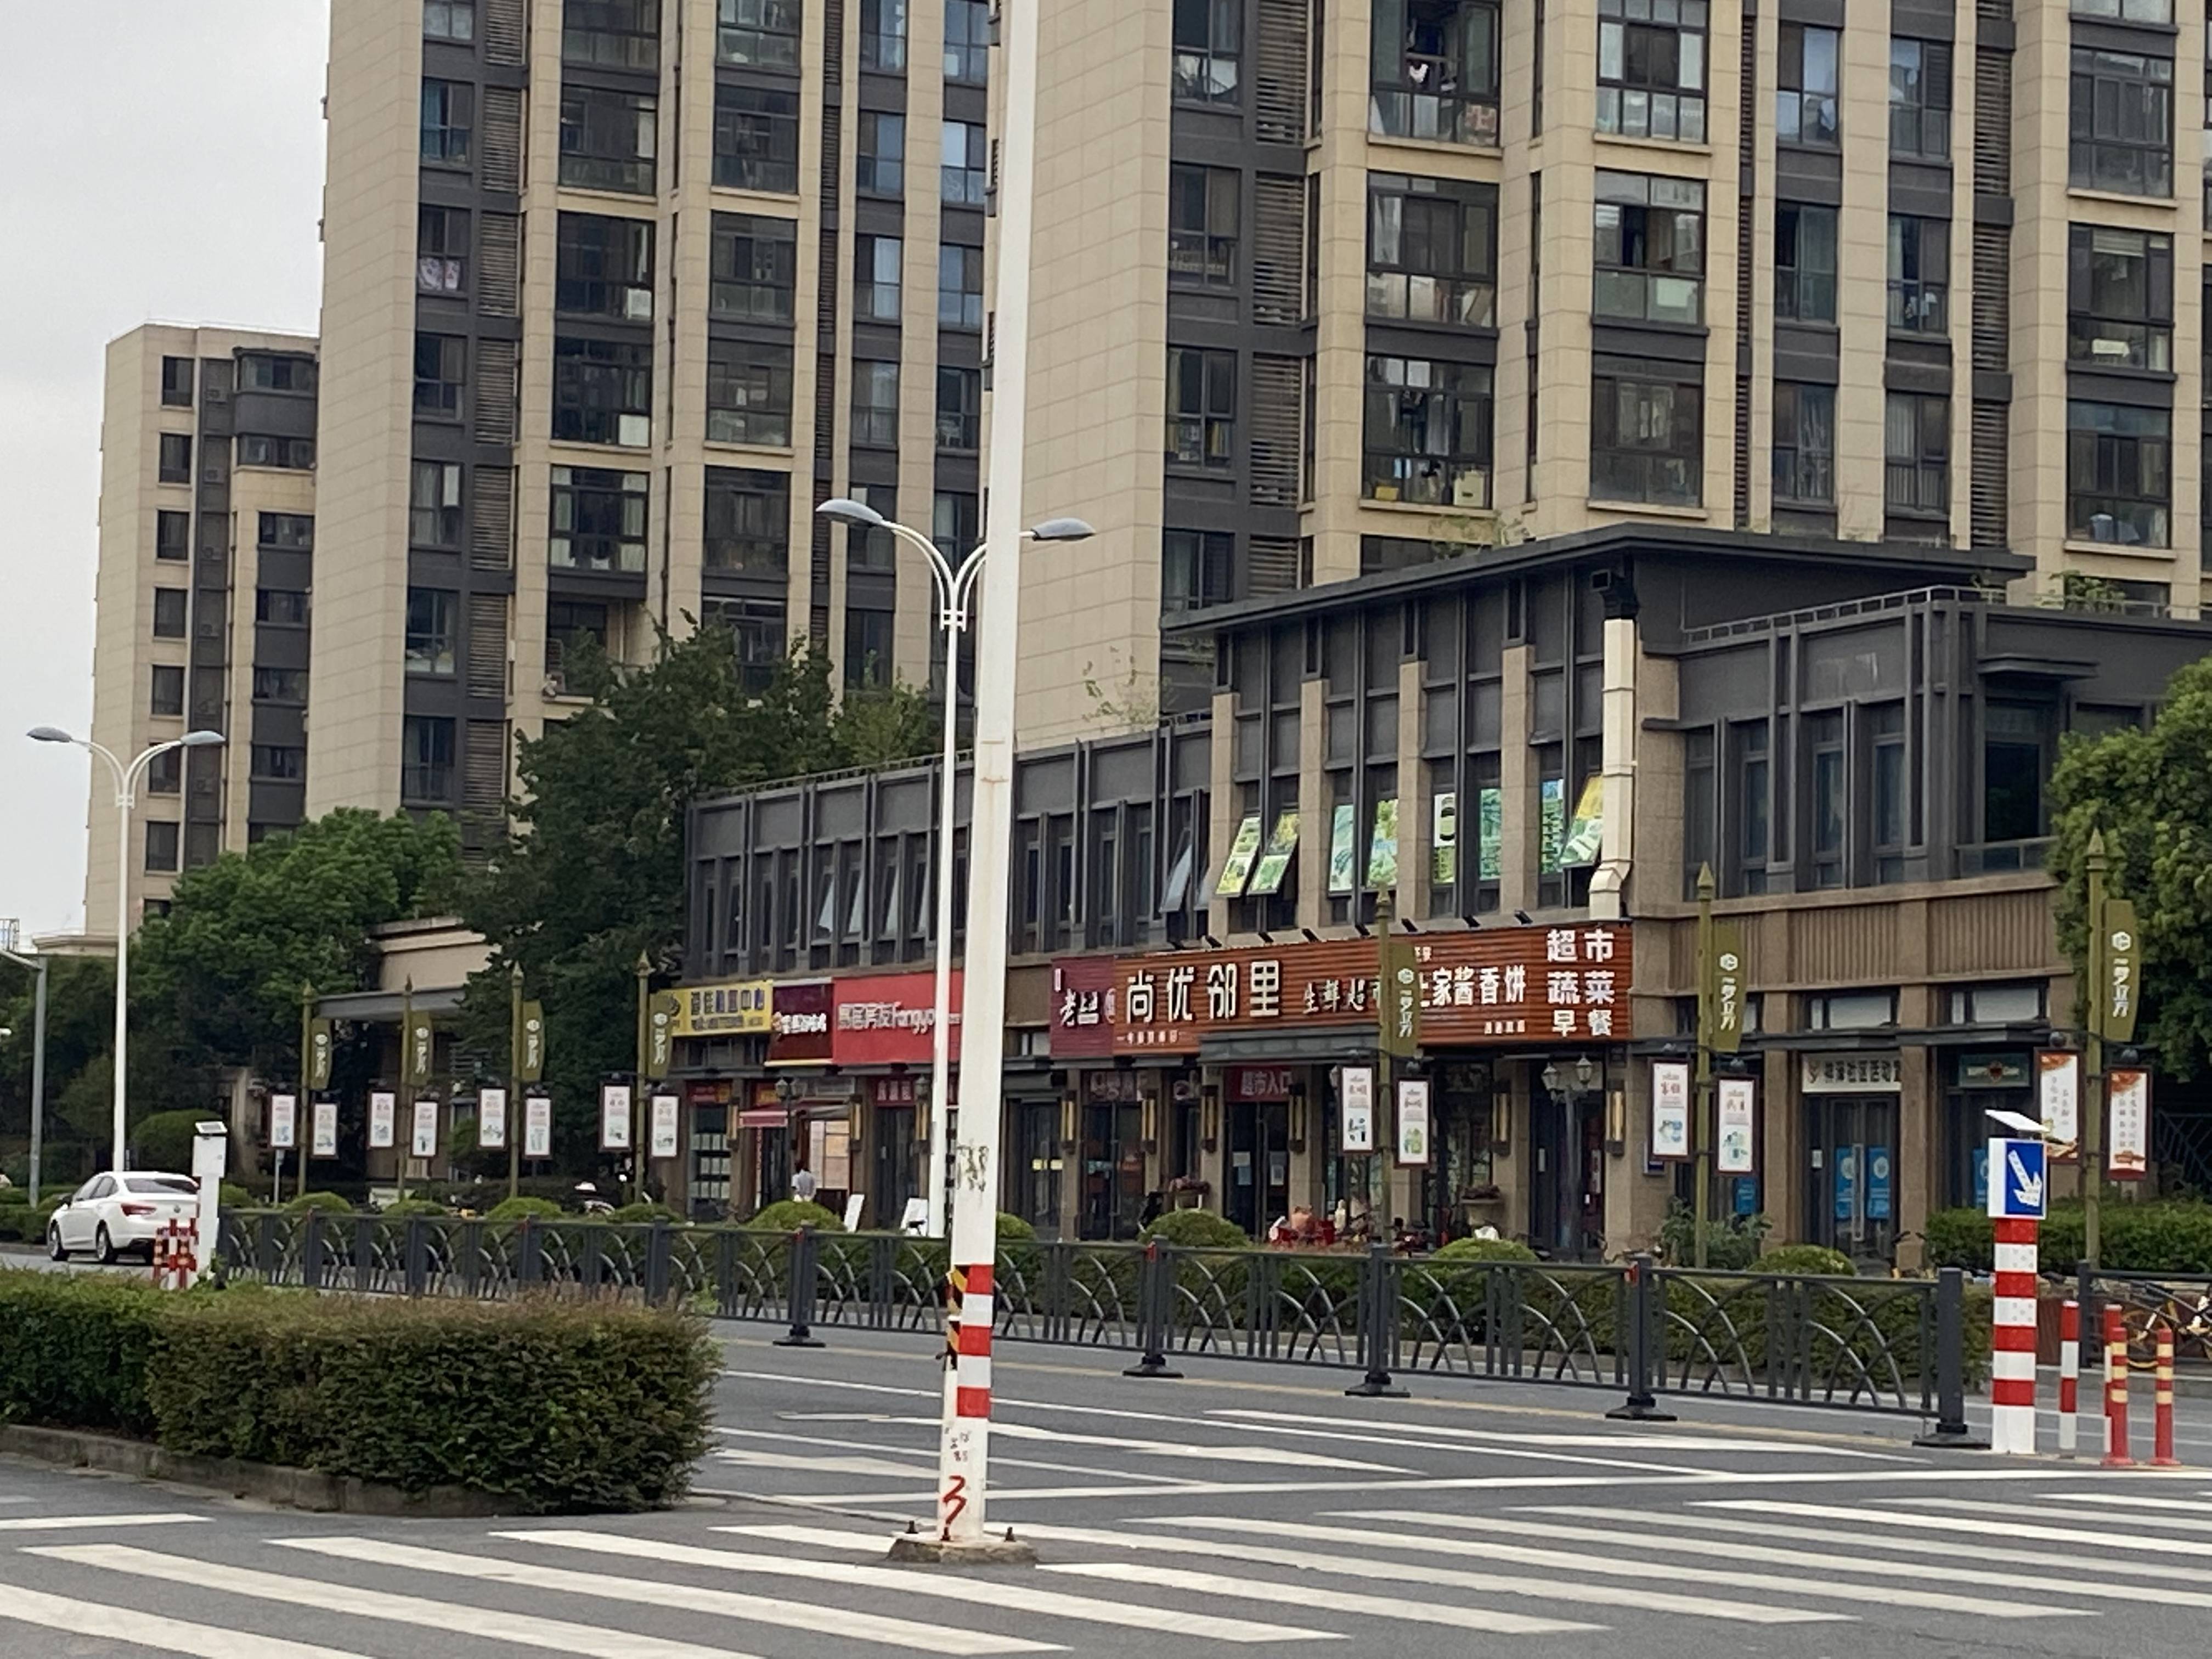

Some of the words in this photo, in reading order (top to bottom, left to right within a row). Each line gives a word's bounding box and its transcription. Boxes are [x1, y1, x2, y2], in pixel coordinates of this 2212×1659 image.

[1547, 928, 1615, 962] 超市
[1126, 960, 1280, 1024] 尚优邻里
[1547, 970, 1615, 1005] 蔬菜
[1552, 1009, 1612, 1037] 早餐
